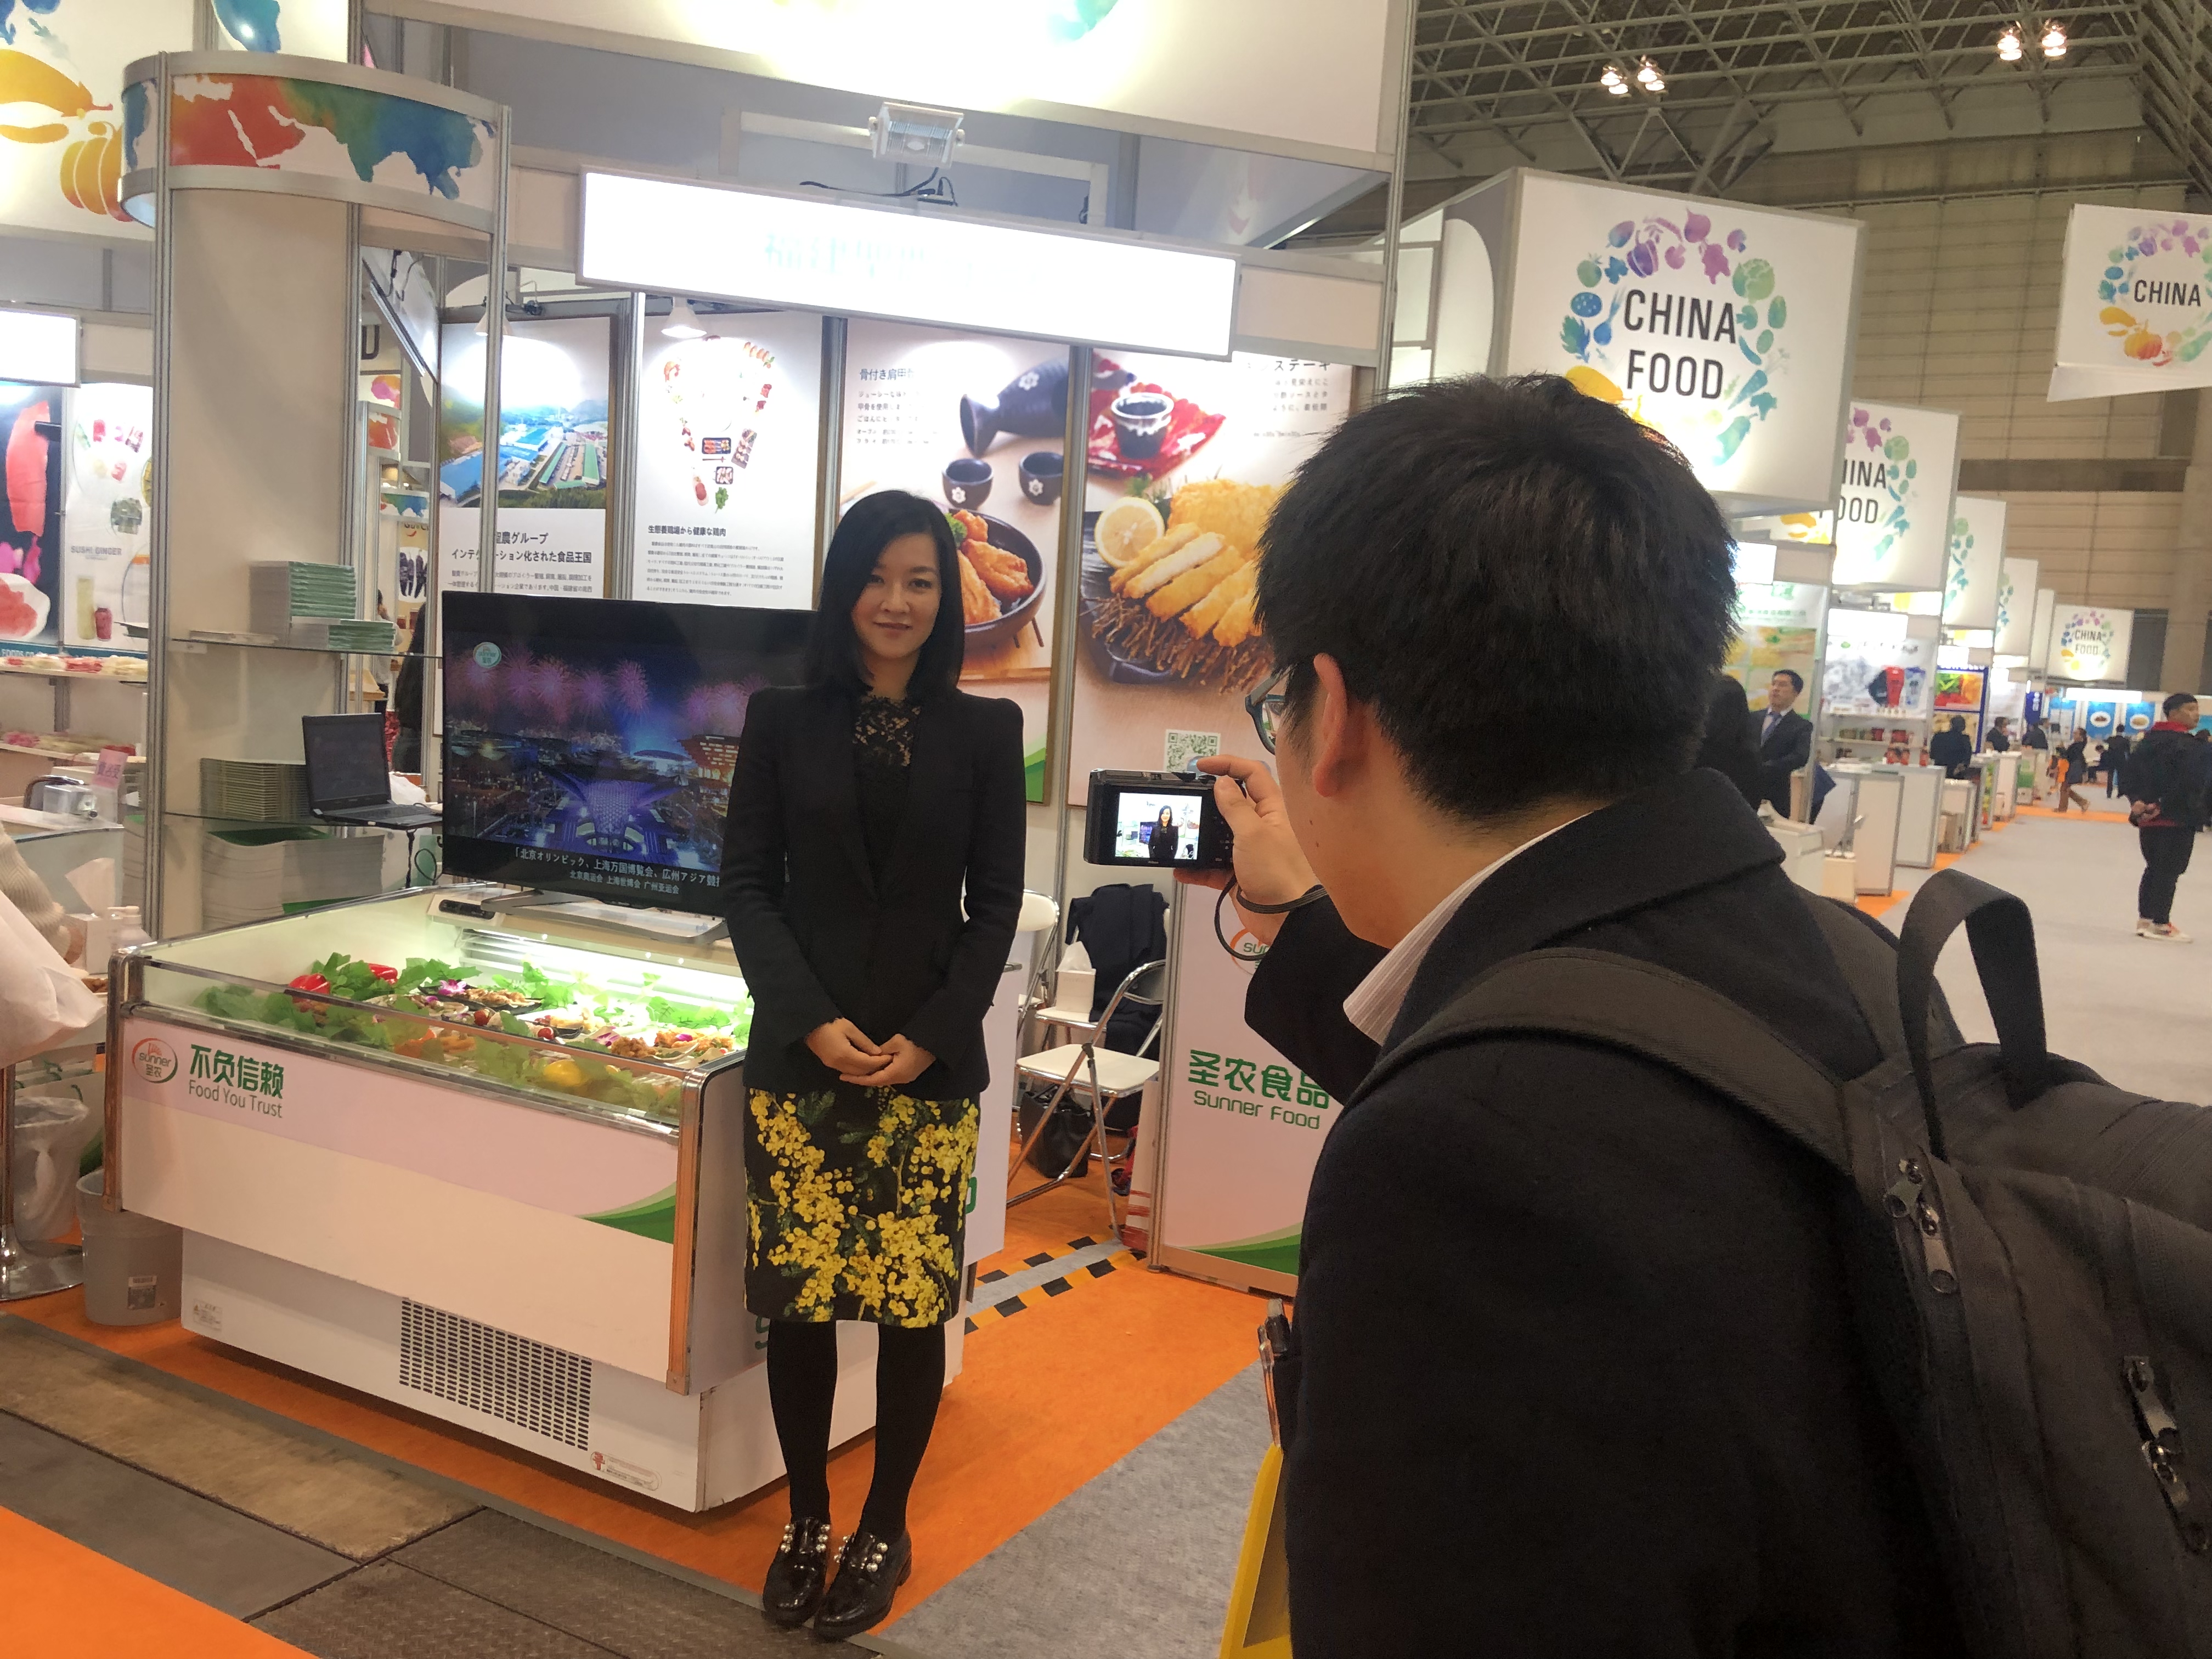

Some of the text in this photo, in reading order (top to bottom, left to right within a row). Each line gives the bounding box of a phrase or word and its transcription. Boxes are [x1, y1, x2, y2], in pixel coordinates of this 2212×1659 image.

[2134, 279, 2201, 307] CHINA
[1623, 289, 1736, 344] CHINA
[1627, 349, 1724, 400] FOOD
[1842, 459, 1886, 488] INA
[1838, 496, 1878, 523] OOD
[71, 545, 122, 555] SUSHI GINGER
[2074, 630, 2102, 641] CHINA
[2075, 644, 2099, 656] FOOD
[189, 1044, 285, 1099] 不负信赖
[1188, 1049, 1329, 1109] 圣农食品
[189, 1079, 283, 1118] Food You Trust
[1193, 1090, 1320, 1130] Sunner Food
